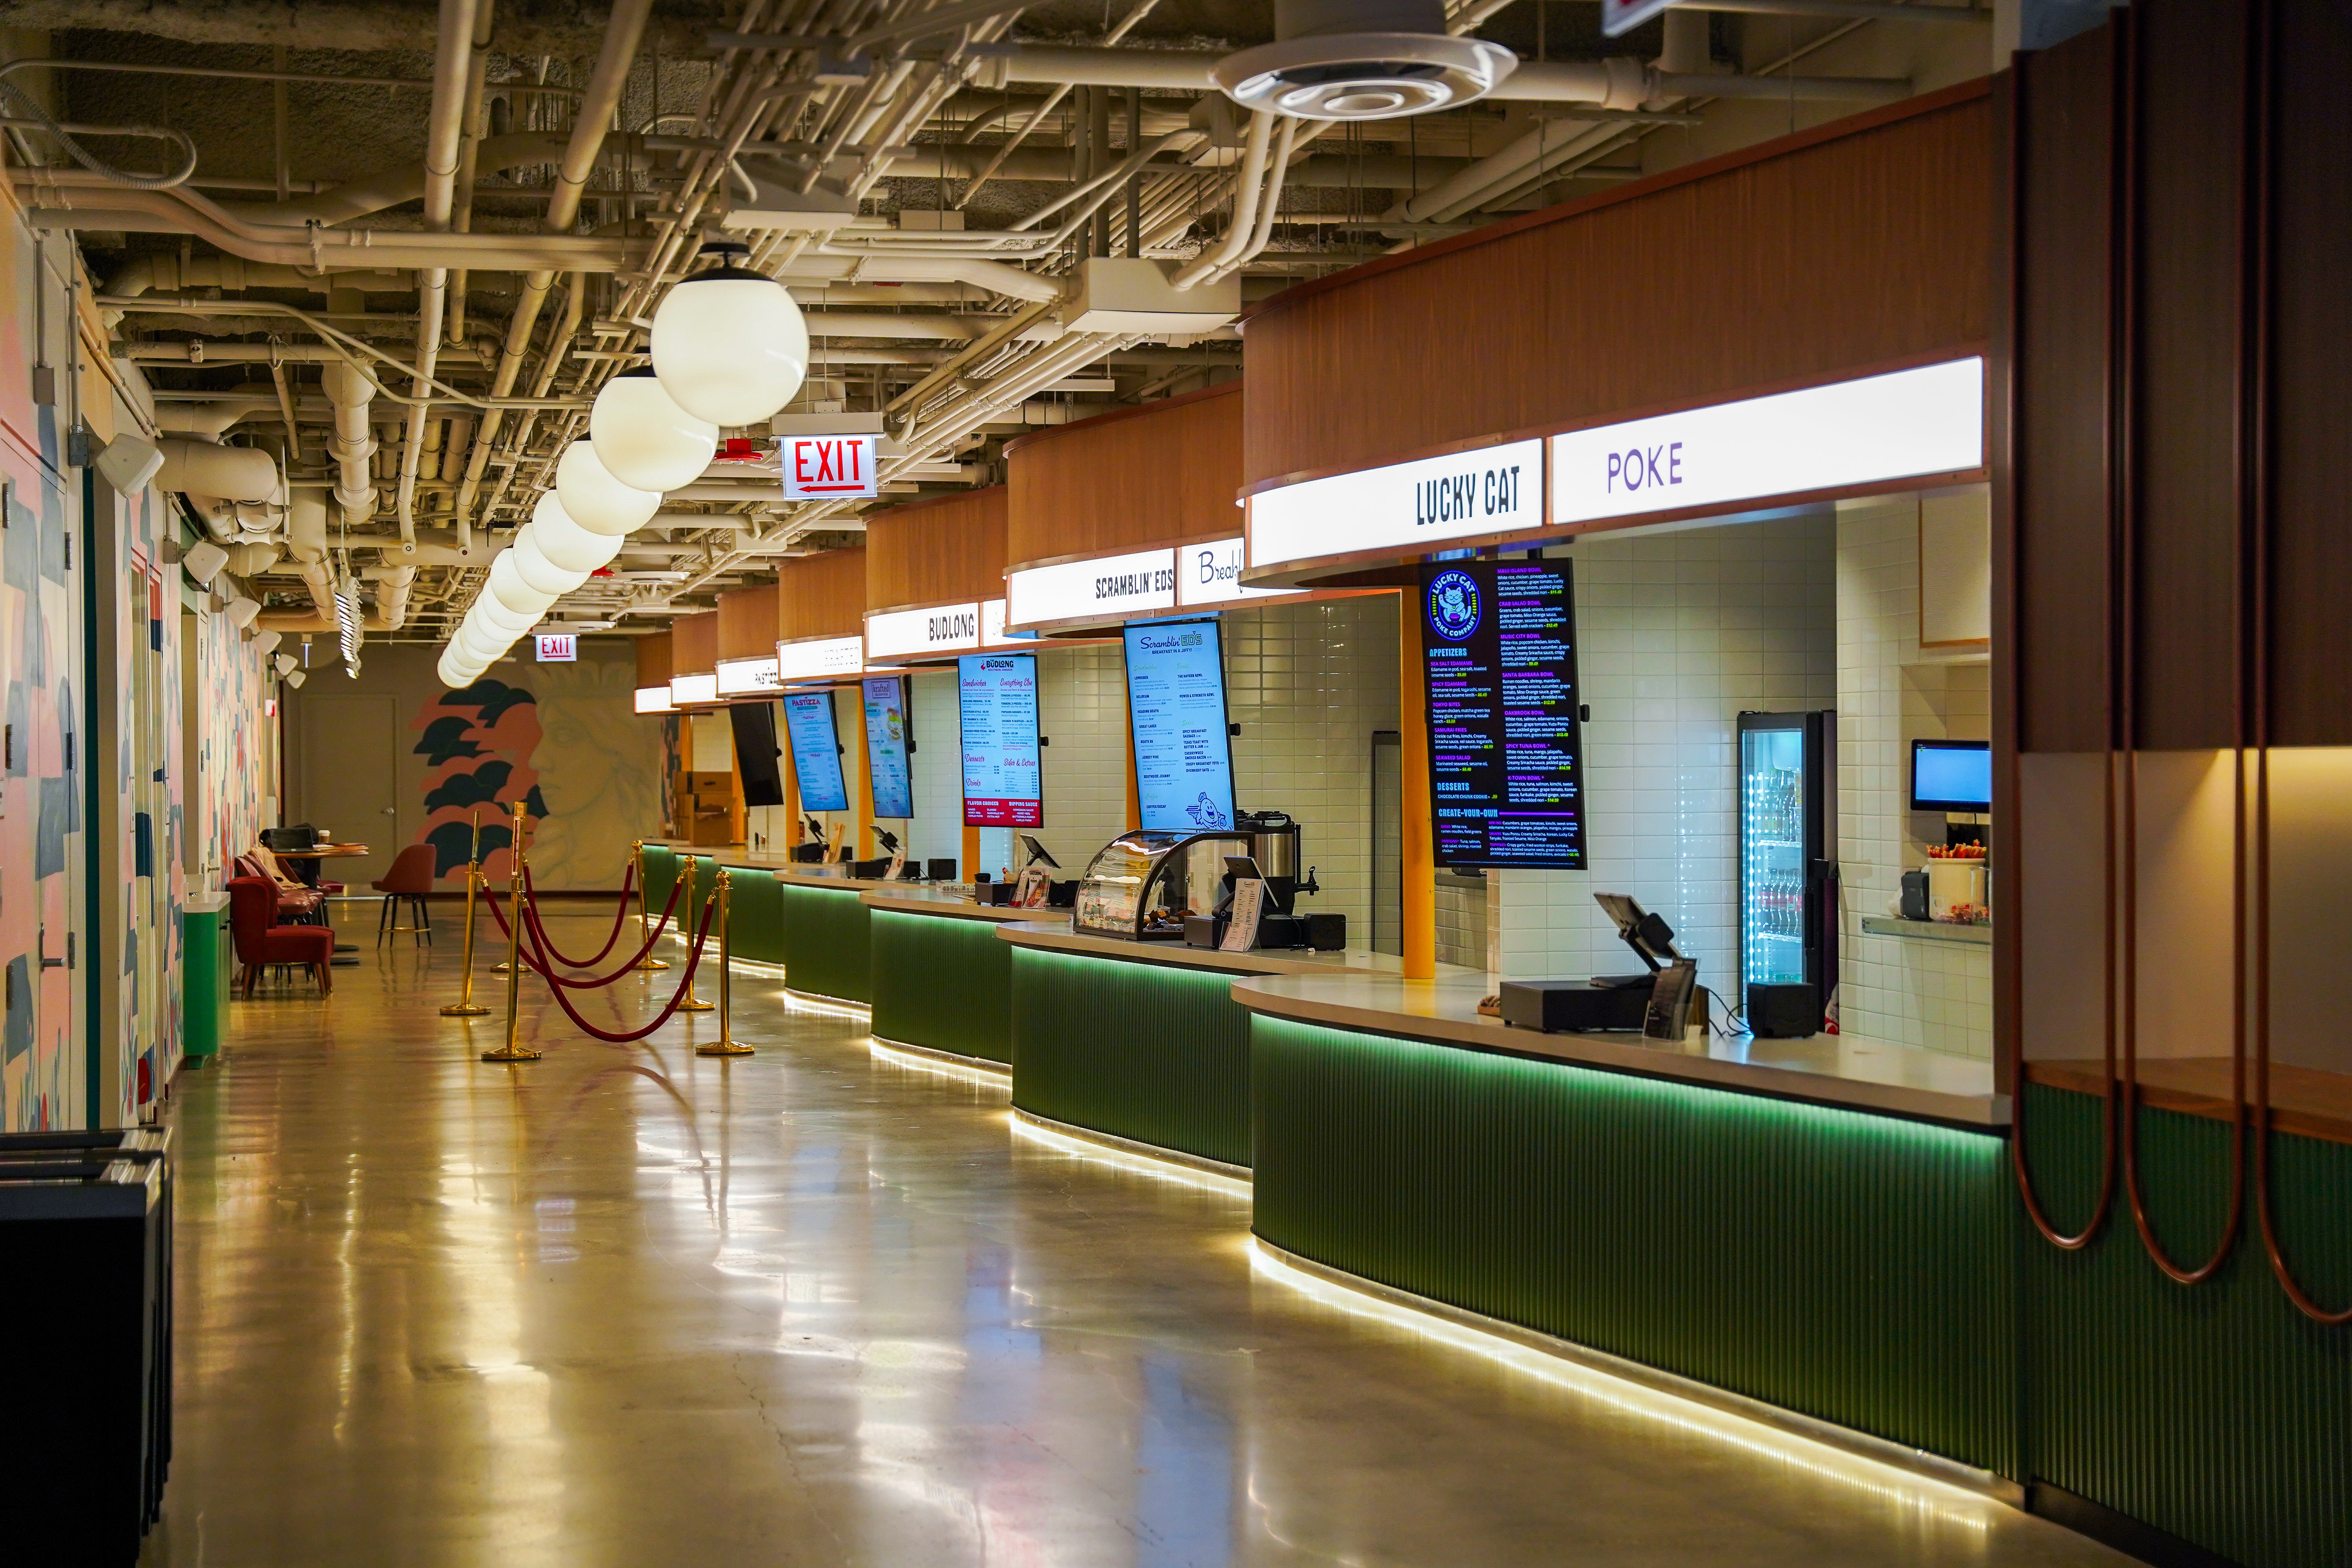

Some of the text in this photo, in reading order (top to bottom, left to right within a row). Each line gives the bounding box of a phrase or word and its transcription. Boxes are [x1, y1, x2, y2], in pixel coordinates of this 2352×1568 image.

[795, 440, 862, 482] EXIT
[1608, 442, 1682, 493] POKE
[1417, 466, 1519, 525] LUCKY CAT
[1096, 569, 1172, 599] SCRAMBLIN' EDS
[1432, 573, 1475, 594] LUCKY CAT
[929, 613, 974, 641] BUDLONG
[1434, 615, 1476, 637] POKE COMPANY
[542, 637, 570, 653] EXIT
[1141, 631, 1202, 649] Scramblin' ED'S
[1429, 648, 1467, 657] APPETIZERS
[873, 684, 889, 693] krafted
[1000, 678, 1032, 687] Everything Else
[965, 754, 984, 762] Desserts
[1004, 758, 1014, 766] Sides
[1022, 758, 1035, 766] Extras
[966, 778, 981, 787] Drinks
[1439, 809, 1498, 817] CREATE-YOUR-OWN
